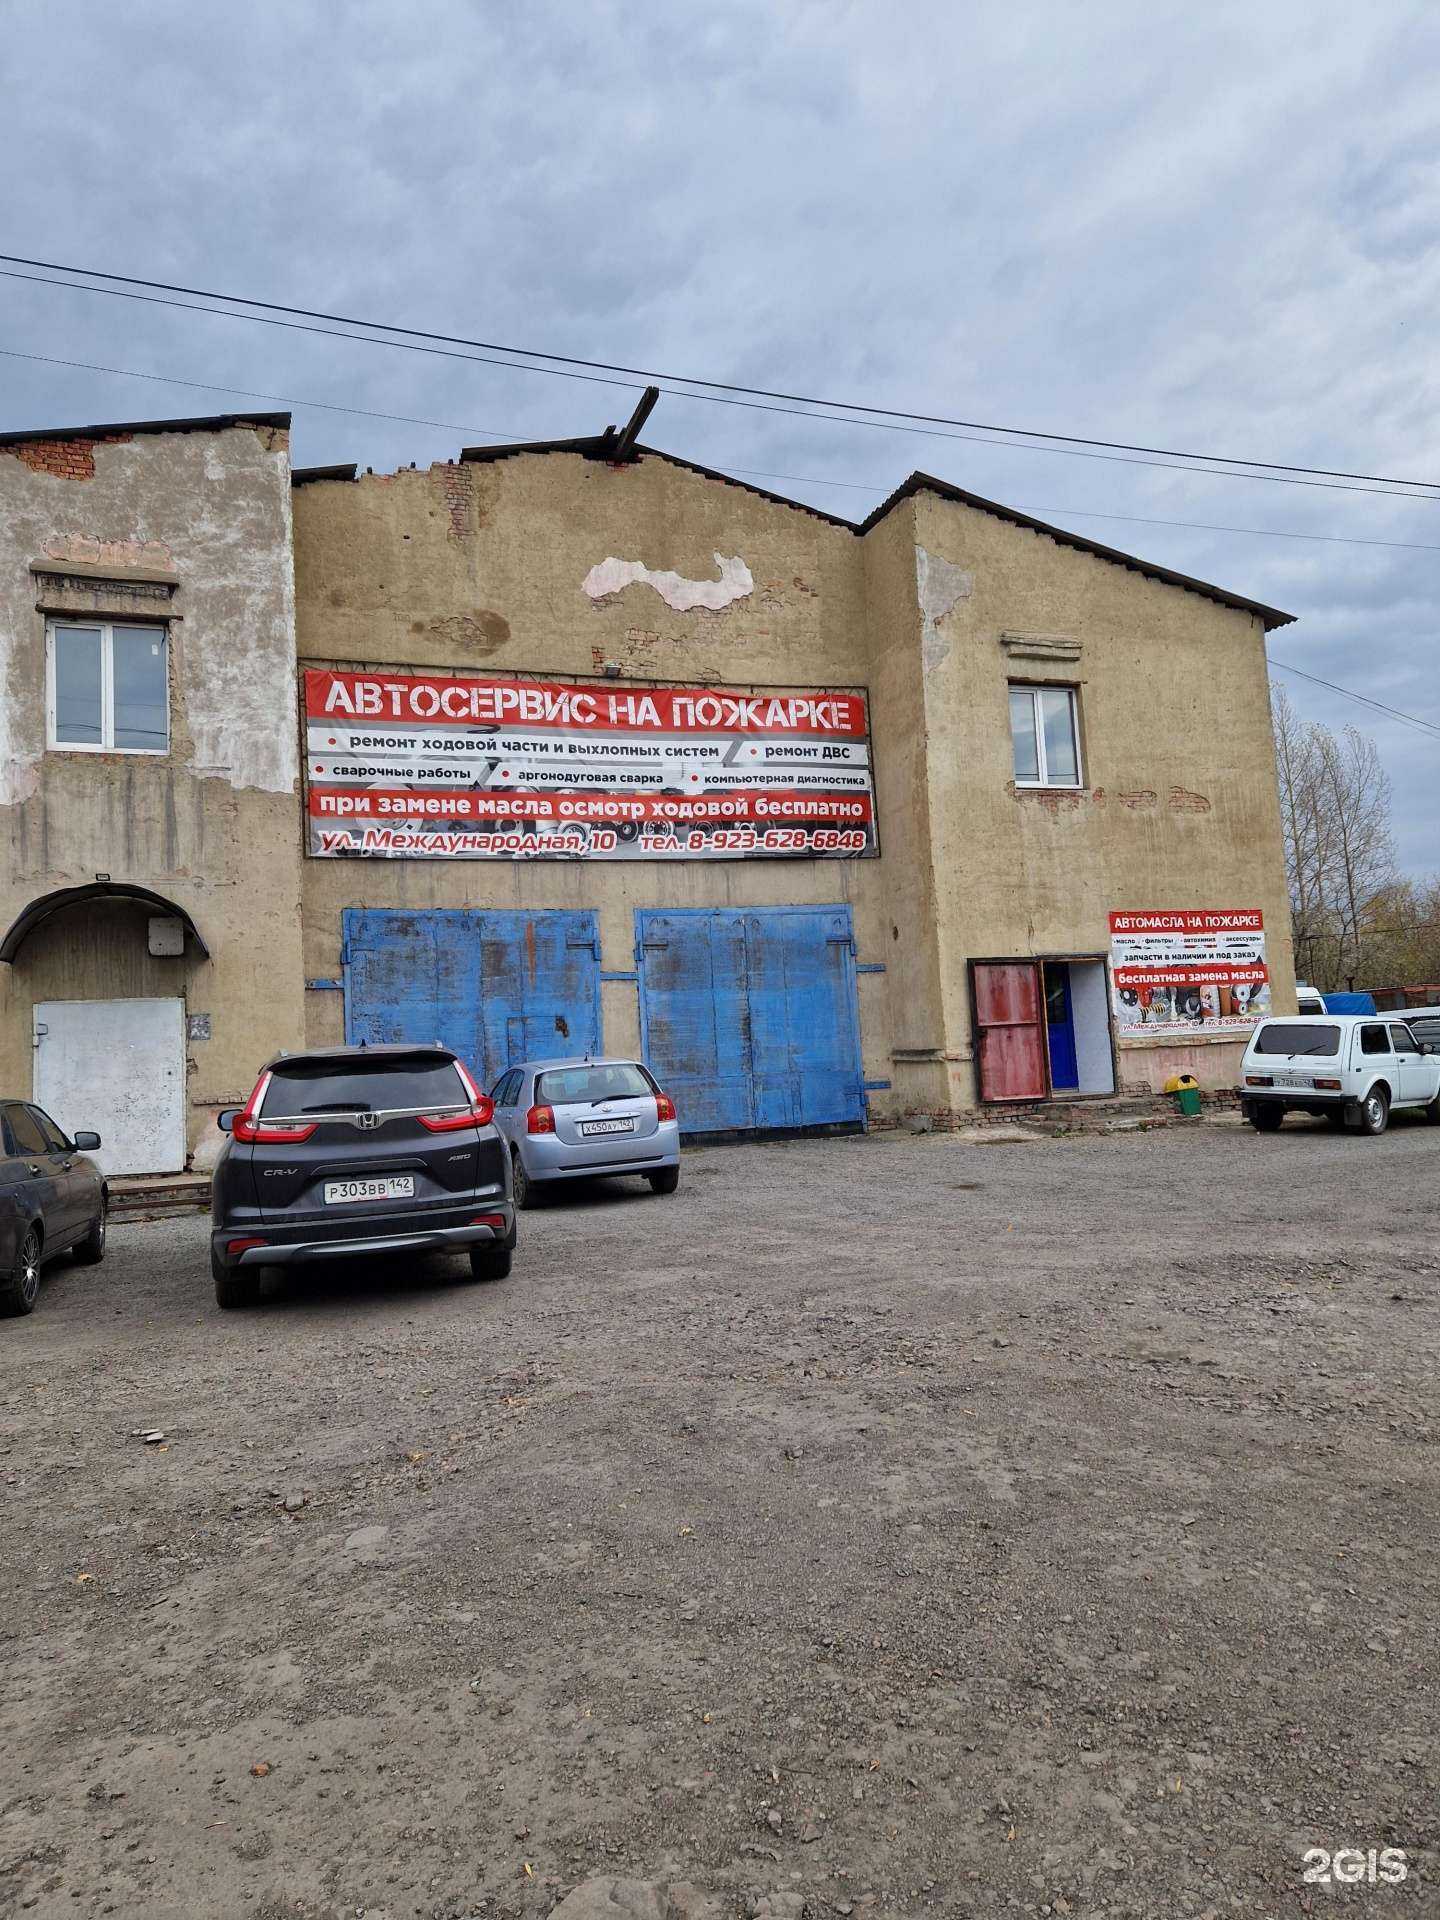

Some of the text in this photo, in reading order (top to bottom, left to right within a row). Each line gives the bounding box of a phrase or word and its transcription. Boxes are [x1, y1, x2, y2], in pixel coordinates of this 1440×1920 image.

[325, 681, 852, 729] АВТОСЕРВИС НА ПОЖАРКЕ
[350, 734, 719, 757] ремонт ходовой части и выхлопных систем
[765, 746, 850, 760] ремонт ДВС
[333, 765, 471, 779] сварочные работы
[518, 769, 663, 785] аргонодуговая сварка
[704, 774, 865, 787] компьютерная диагностика
[320, 796, 863, 818] при замене масла осмотр ходовой бесплатно
[321, 831, 865, 852] ул. Международная, 10 тел. 8-923-628-6848
[1115, 916, 1259, 928] АВТОМАСЛА НА ПОЖАРКЕ
[1124, 952, 1162, 961] запчасти
[1216, 951, 1231, 960] под
[1119, 970, 1264, 983] бесплатная замена масла
[263, 1168, 298, 1176] CR-V
[389, 1178, 410, 1189] 142
